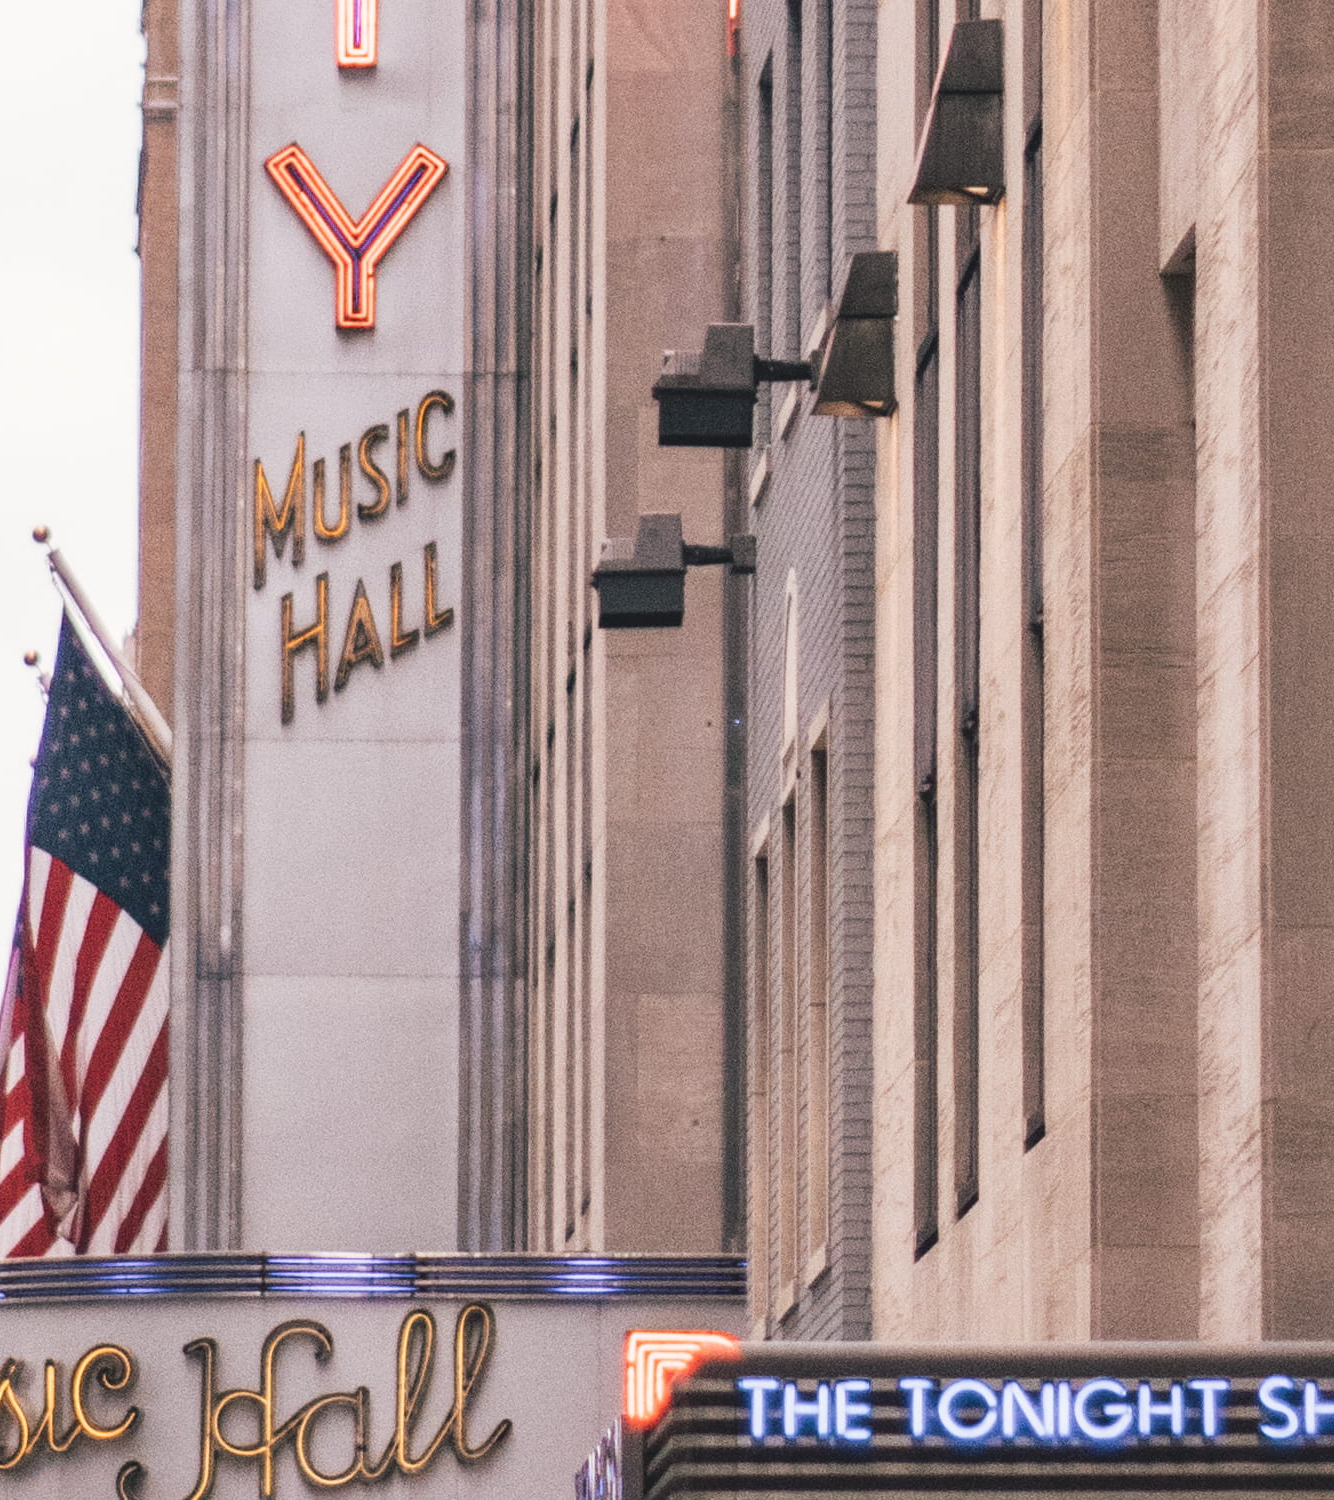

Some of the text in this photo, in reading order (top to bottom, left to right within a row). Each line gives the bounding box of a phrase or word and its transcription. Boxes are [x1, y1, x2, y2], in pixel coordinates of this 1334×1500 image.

[253, 390, 456, 591] MUSIC
[280, 540, 454, 726] HALL
[736, 1375, 873, 1442] THE
[899, 1375, 1231, 1442] TONIGHT
